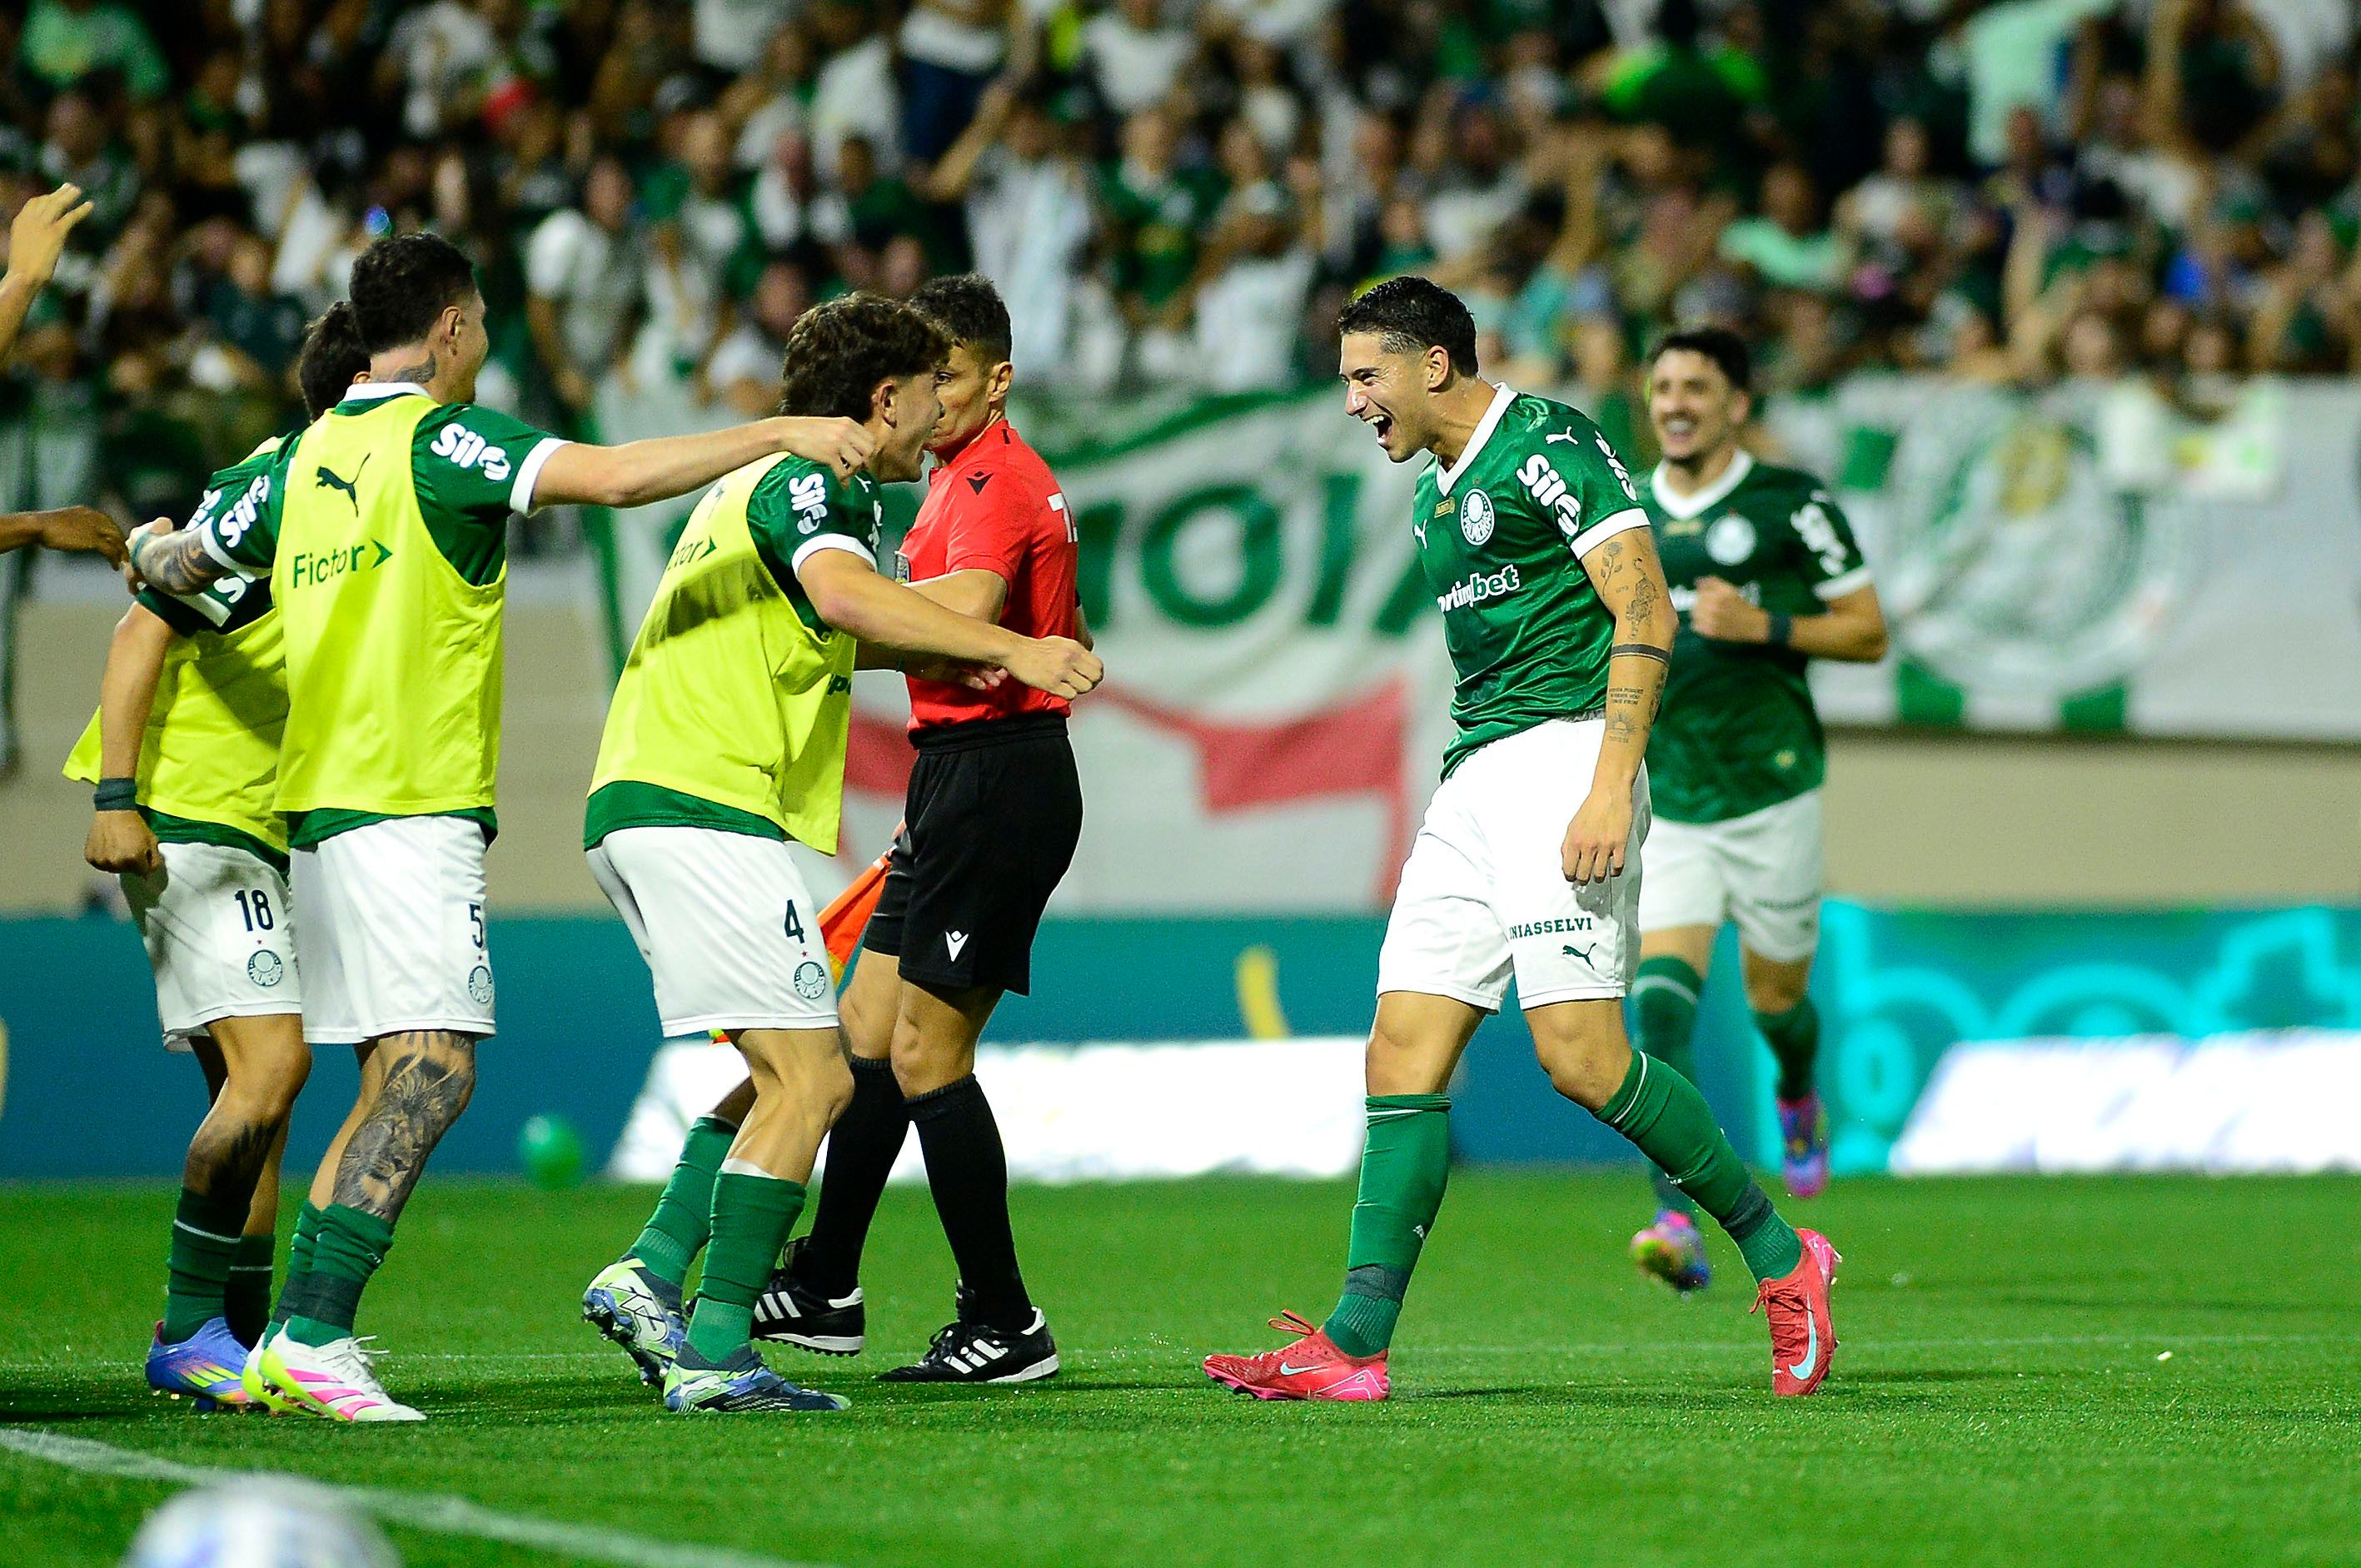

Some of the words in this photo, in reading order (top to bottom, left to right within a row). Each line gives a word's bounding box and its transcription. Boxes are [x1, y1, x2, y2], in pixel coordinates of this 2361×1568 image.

[293, 545, 365, 589] Fictor
[235, 889, 274, 932] 18
[469, 903, 484, 948] 5
[784, 899, 805, 944] 4
[1509, 917, 1592, 940] NIASSELVI
